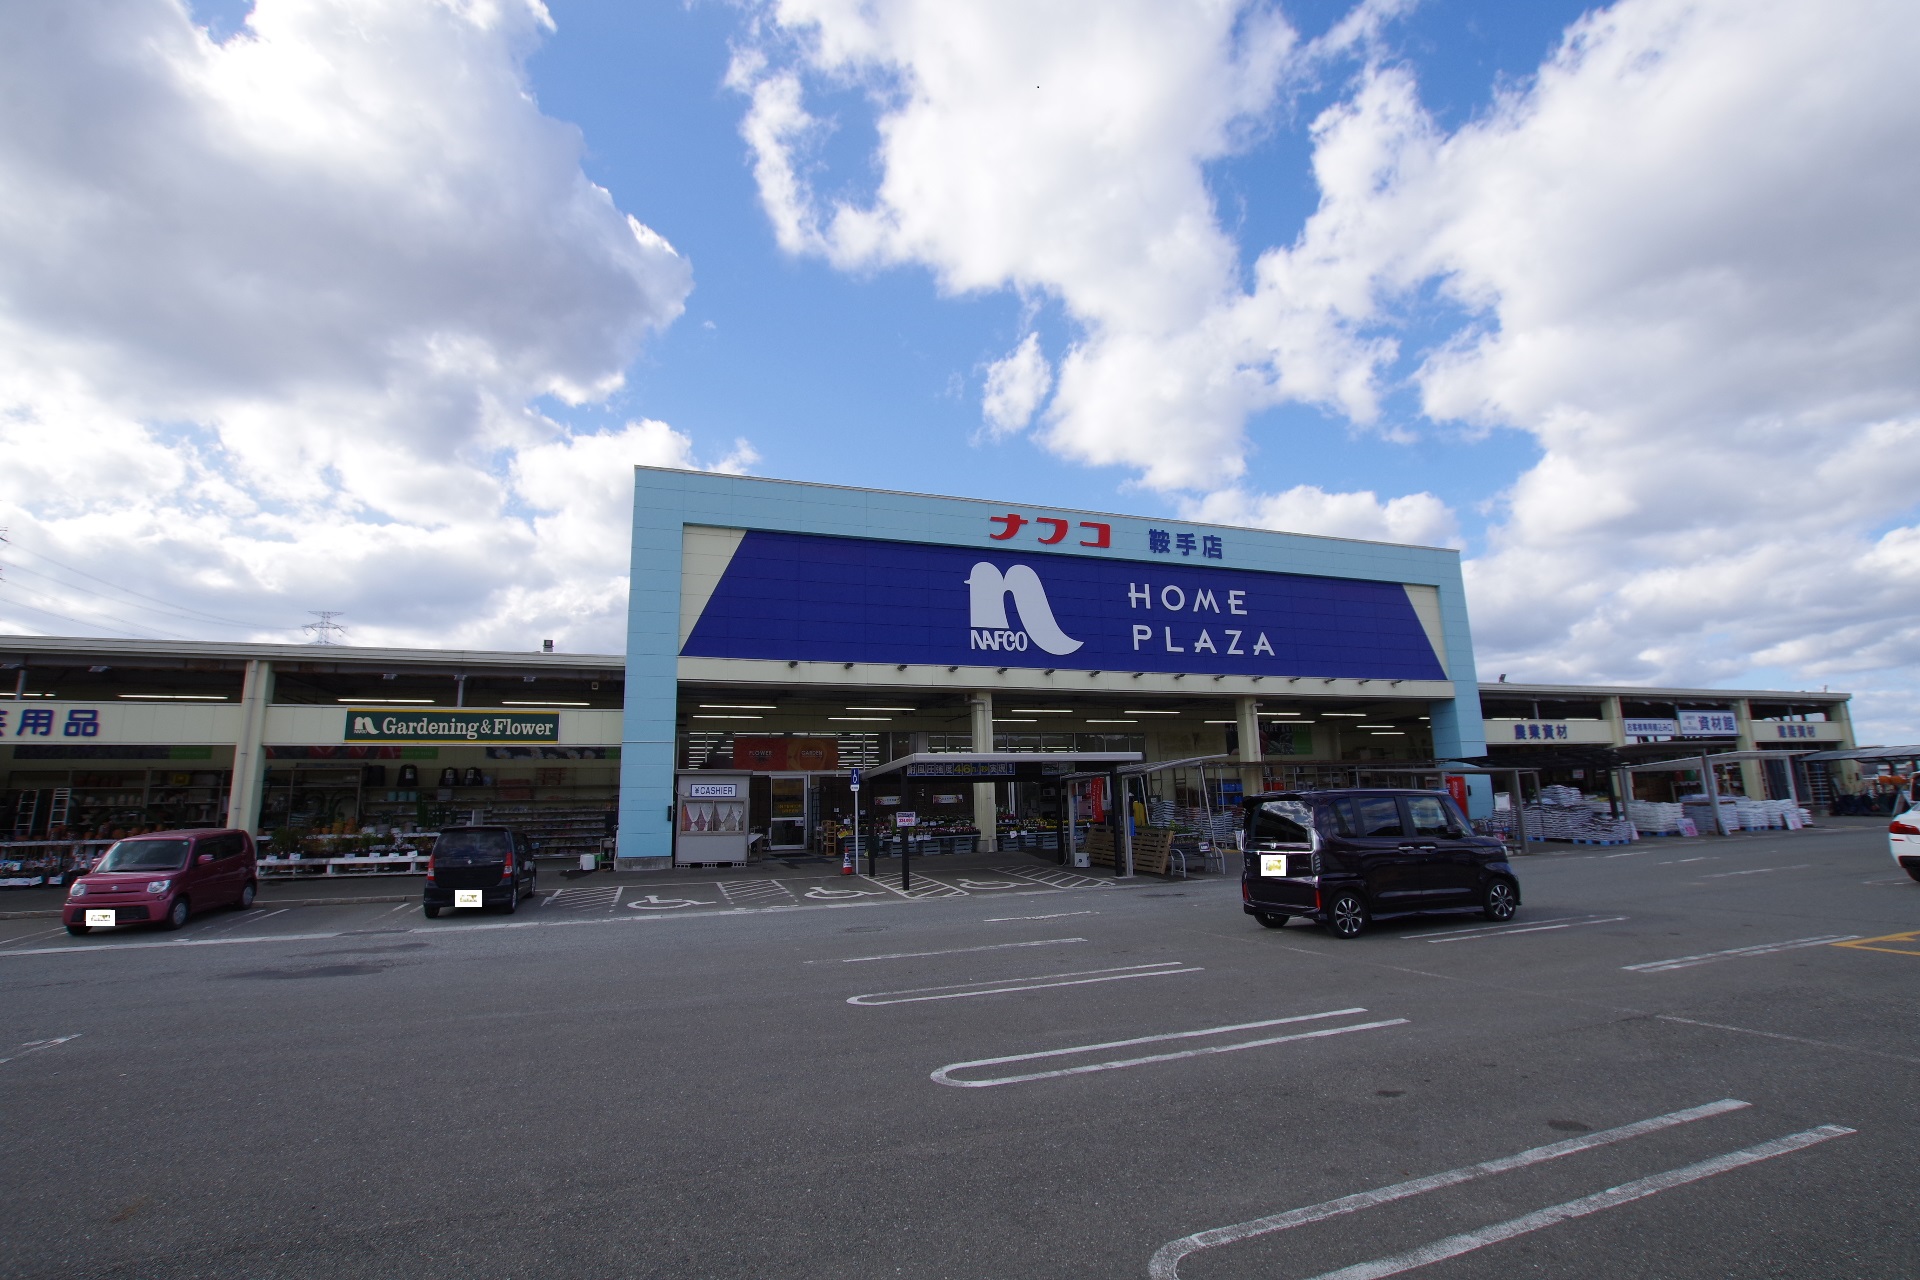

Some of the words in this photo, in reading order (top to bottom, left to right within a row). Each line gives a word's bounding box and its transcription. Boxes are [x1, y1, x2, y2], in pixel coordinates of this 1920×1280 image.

[989, 513, 1111, 549] ナフコ
[1148, 528, 1224, 560] 鞍手店
[1128, 581, 1249, 616] HOME
[969, 629, 1028, 652] NAFCO
[1131, 624, 1276, 657] PLAZA
[1514, 723, 1568, 740] 農業資材
[1698, 715, 1734, 731] 資材館
